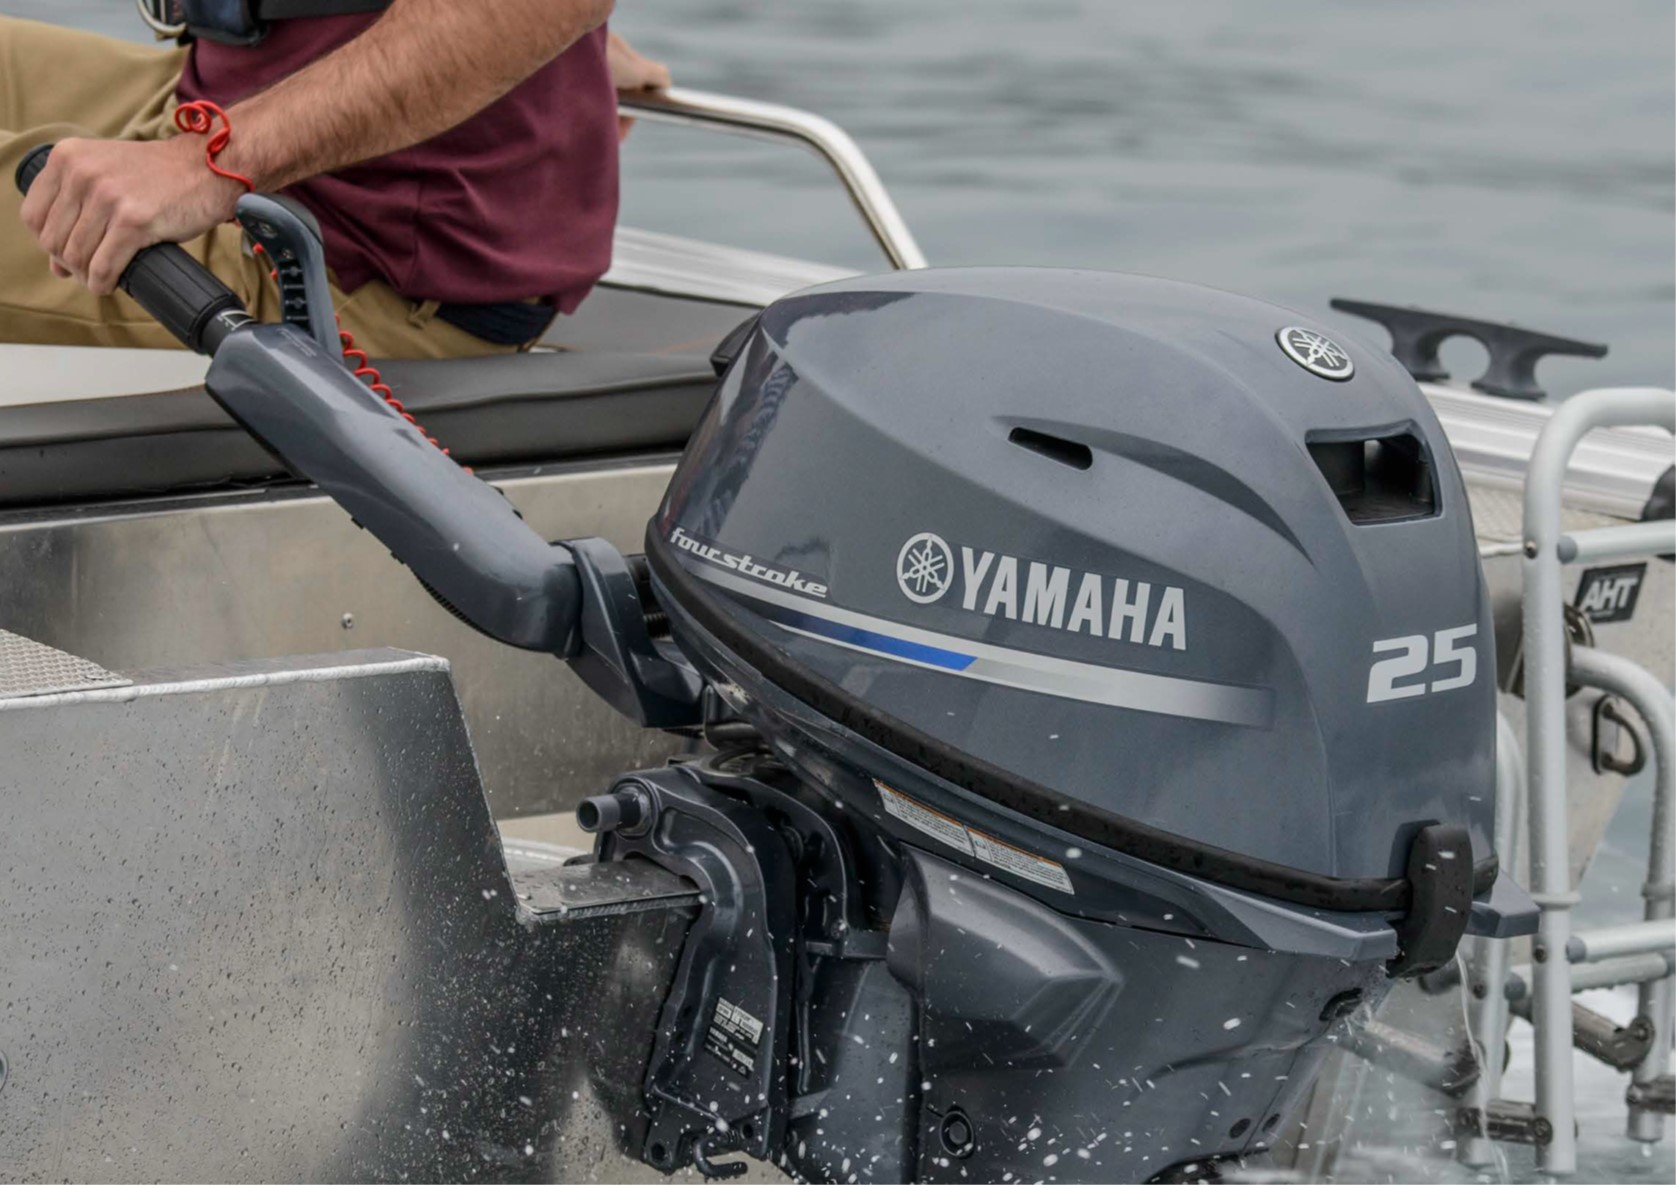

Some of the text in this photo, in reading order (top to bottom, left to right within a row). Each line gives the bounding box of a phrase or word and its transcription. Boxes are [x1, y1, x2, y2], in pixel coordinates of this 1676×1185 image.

[962, 547, 1186, 651] YAMAHA
[1579, 578, 1638, 610] AHT
[1366, 624, 1476, 702] 25
